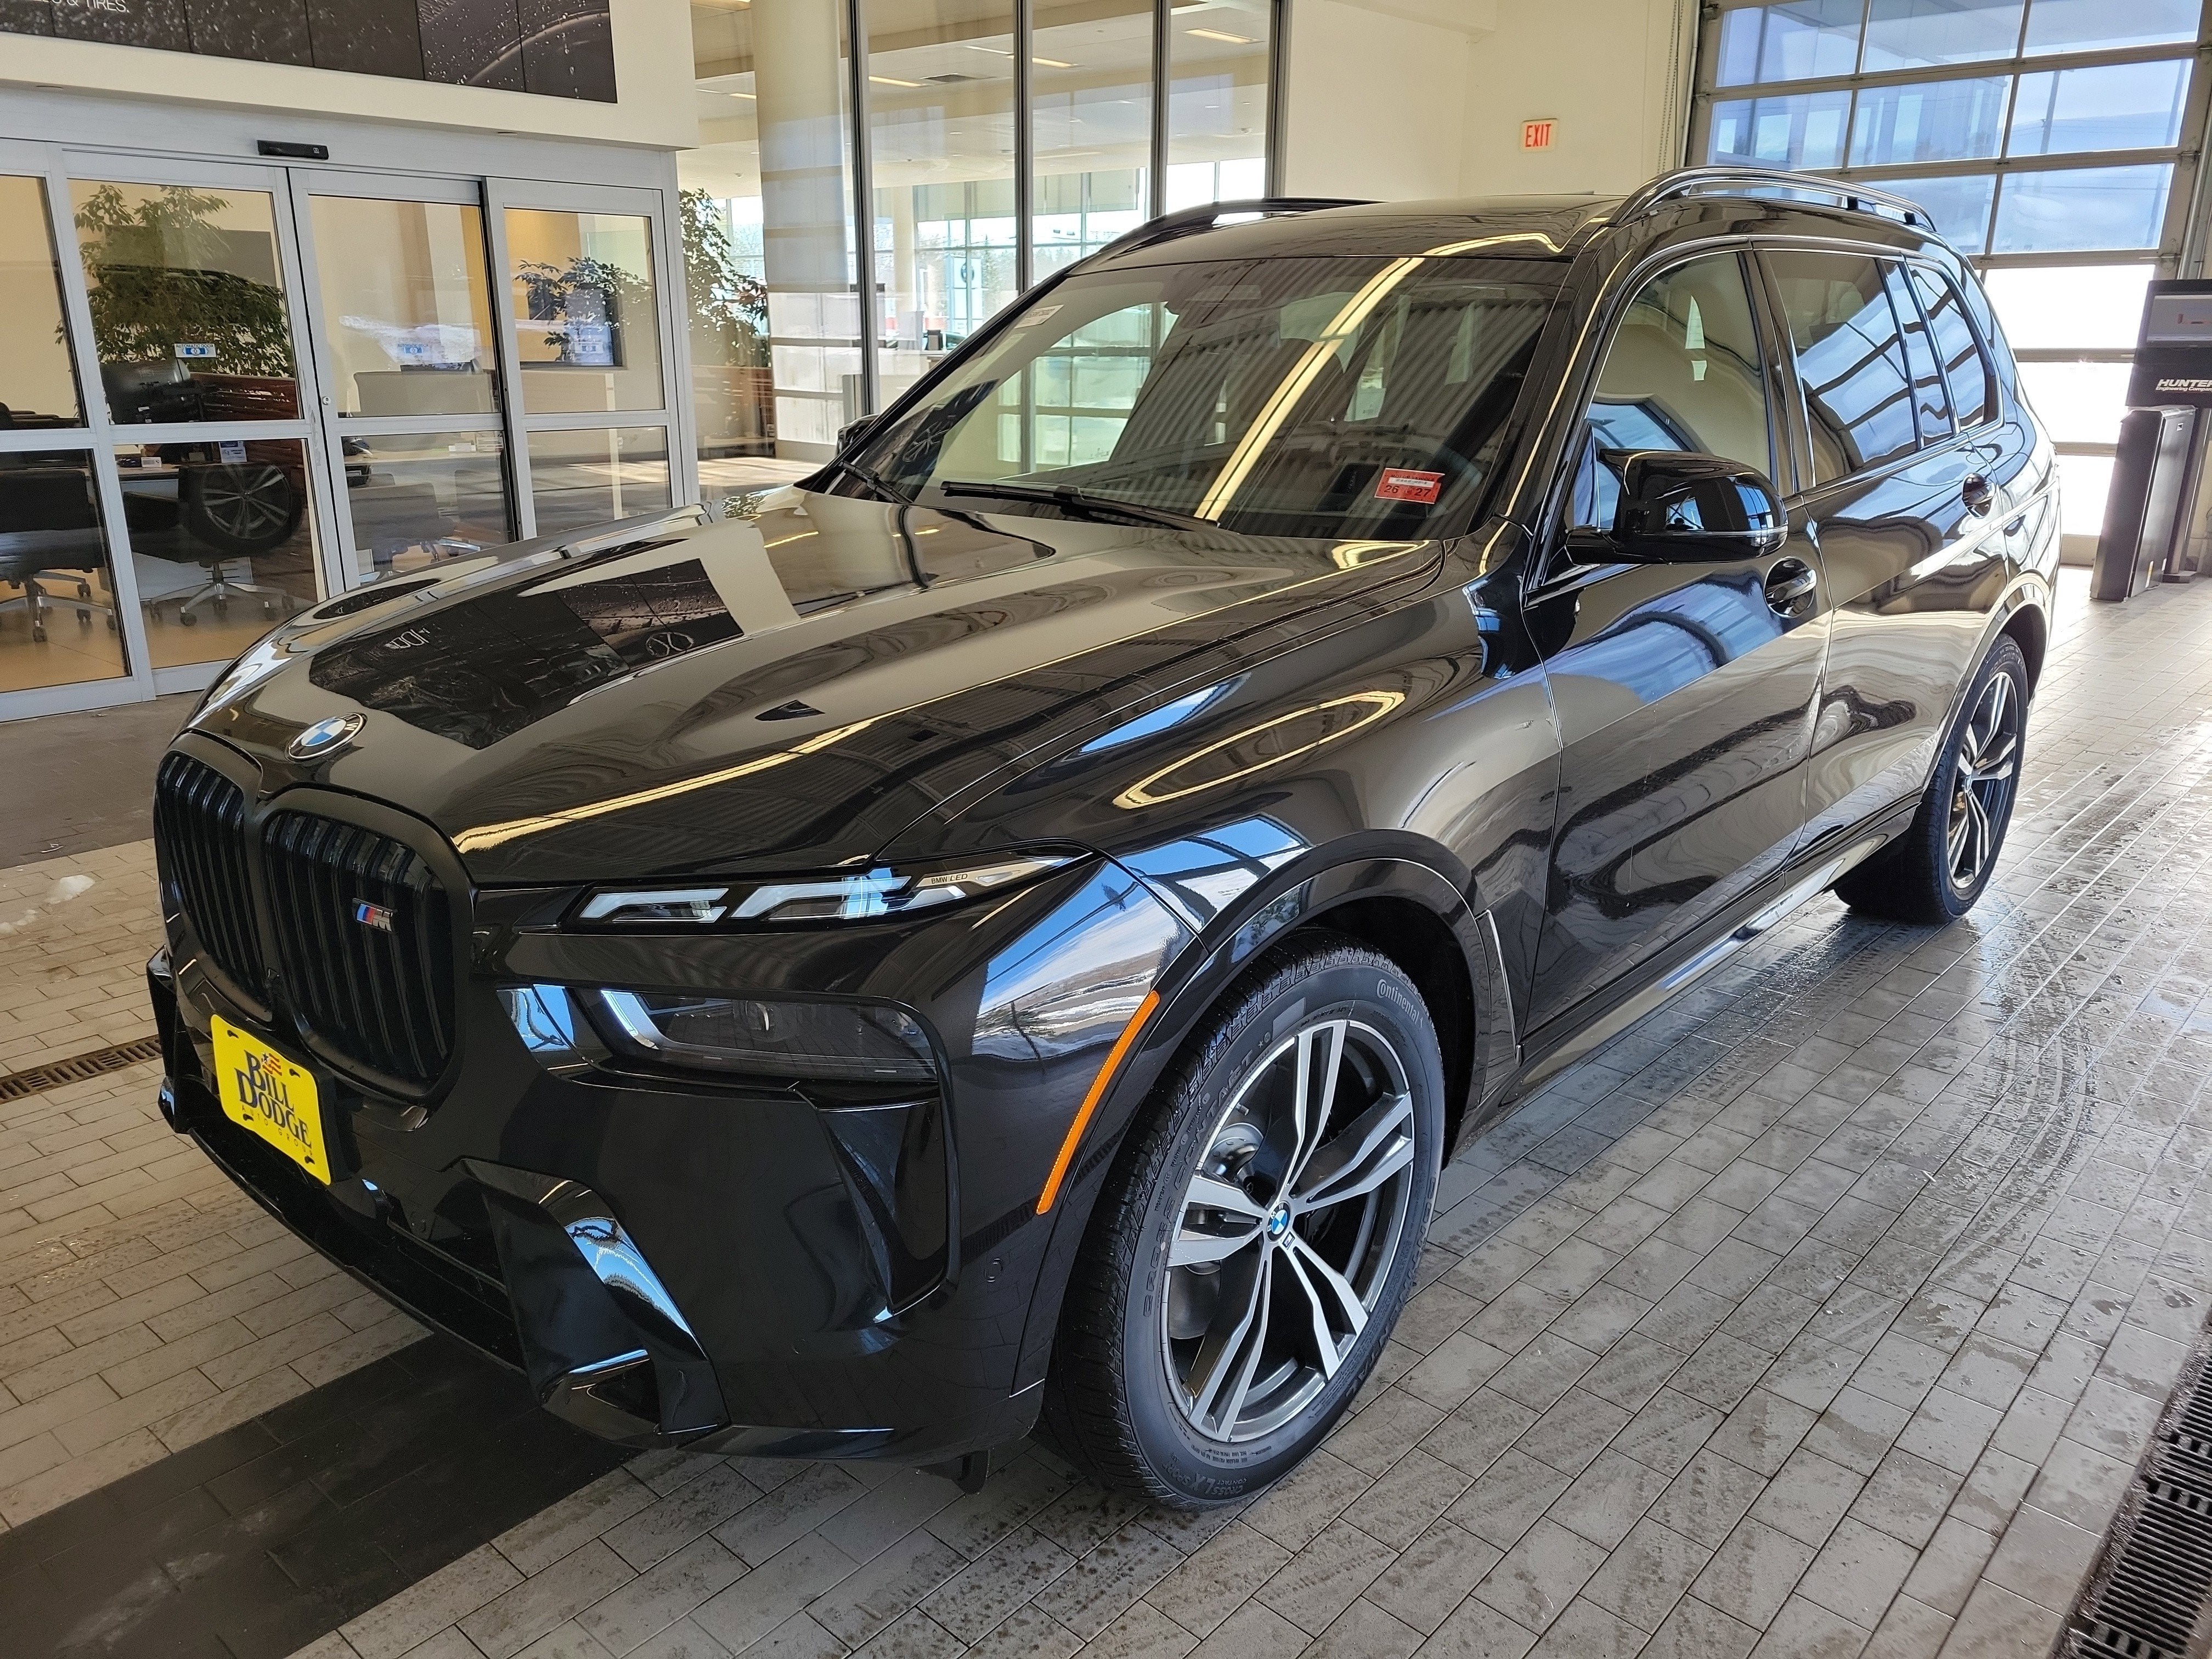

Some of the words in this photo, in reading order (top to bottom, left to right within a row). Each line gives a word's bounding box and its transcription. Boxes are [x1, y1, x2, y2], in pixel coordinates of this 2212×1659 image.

[1525, 123, 1551, 147] EXIT
[1384, 484, 1400, 494] 26
[1414, 488, 1431, 497] 27
[1376, 979, 1419, 1024] Continental
[244, 1049, 294, 1111] BILL
[234, 1068, 312, 1149] DODGE
[241, 1105, 269, 1126] AUTO
[1267, 1203, 1284, 1232] BMW
